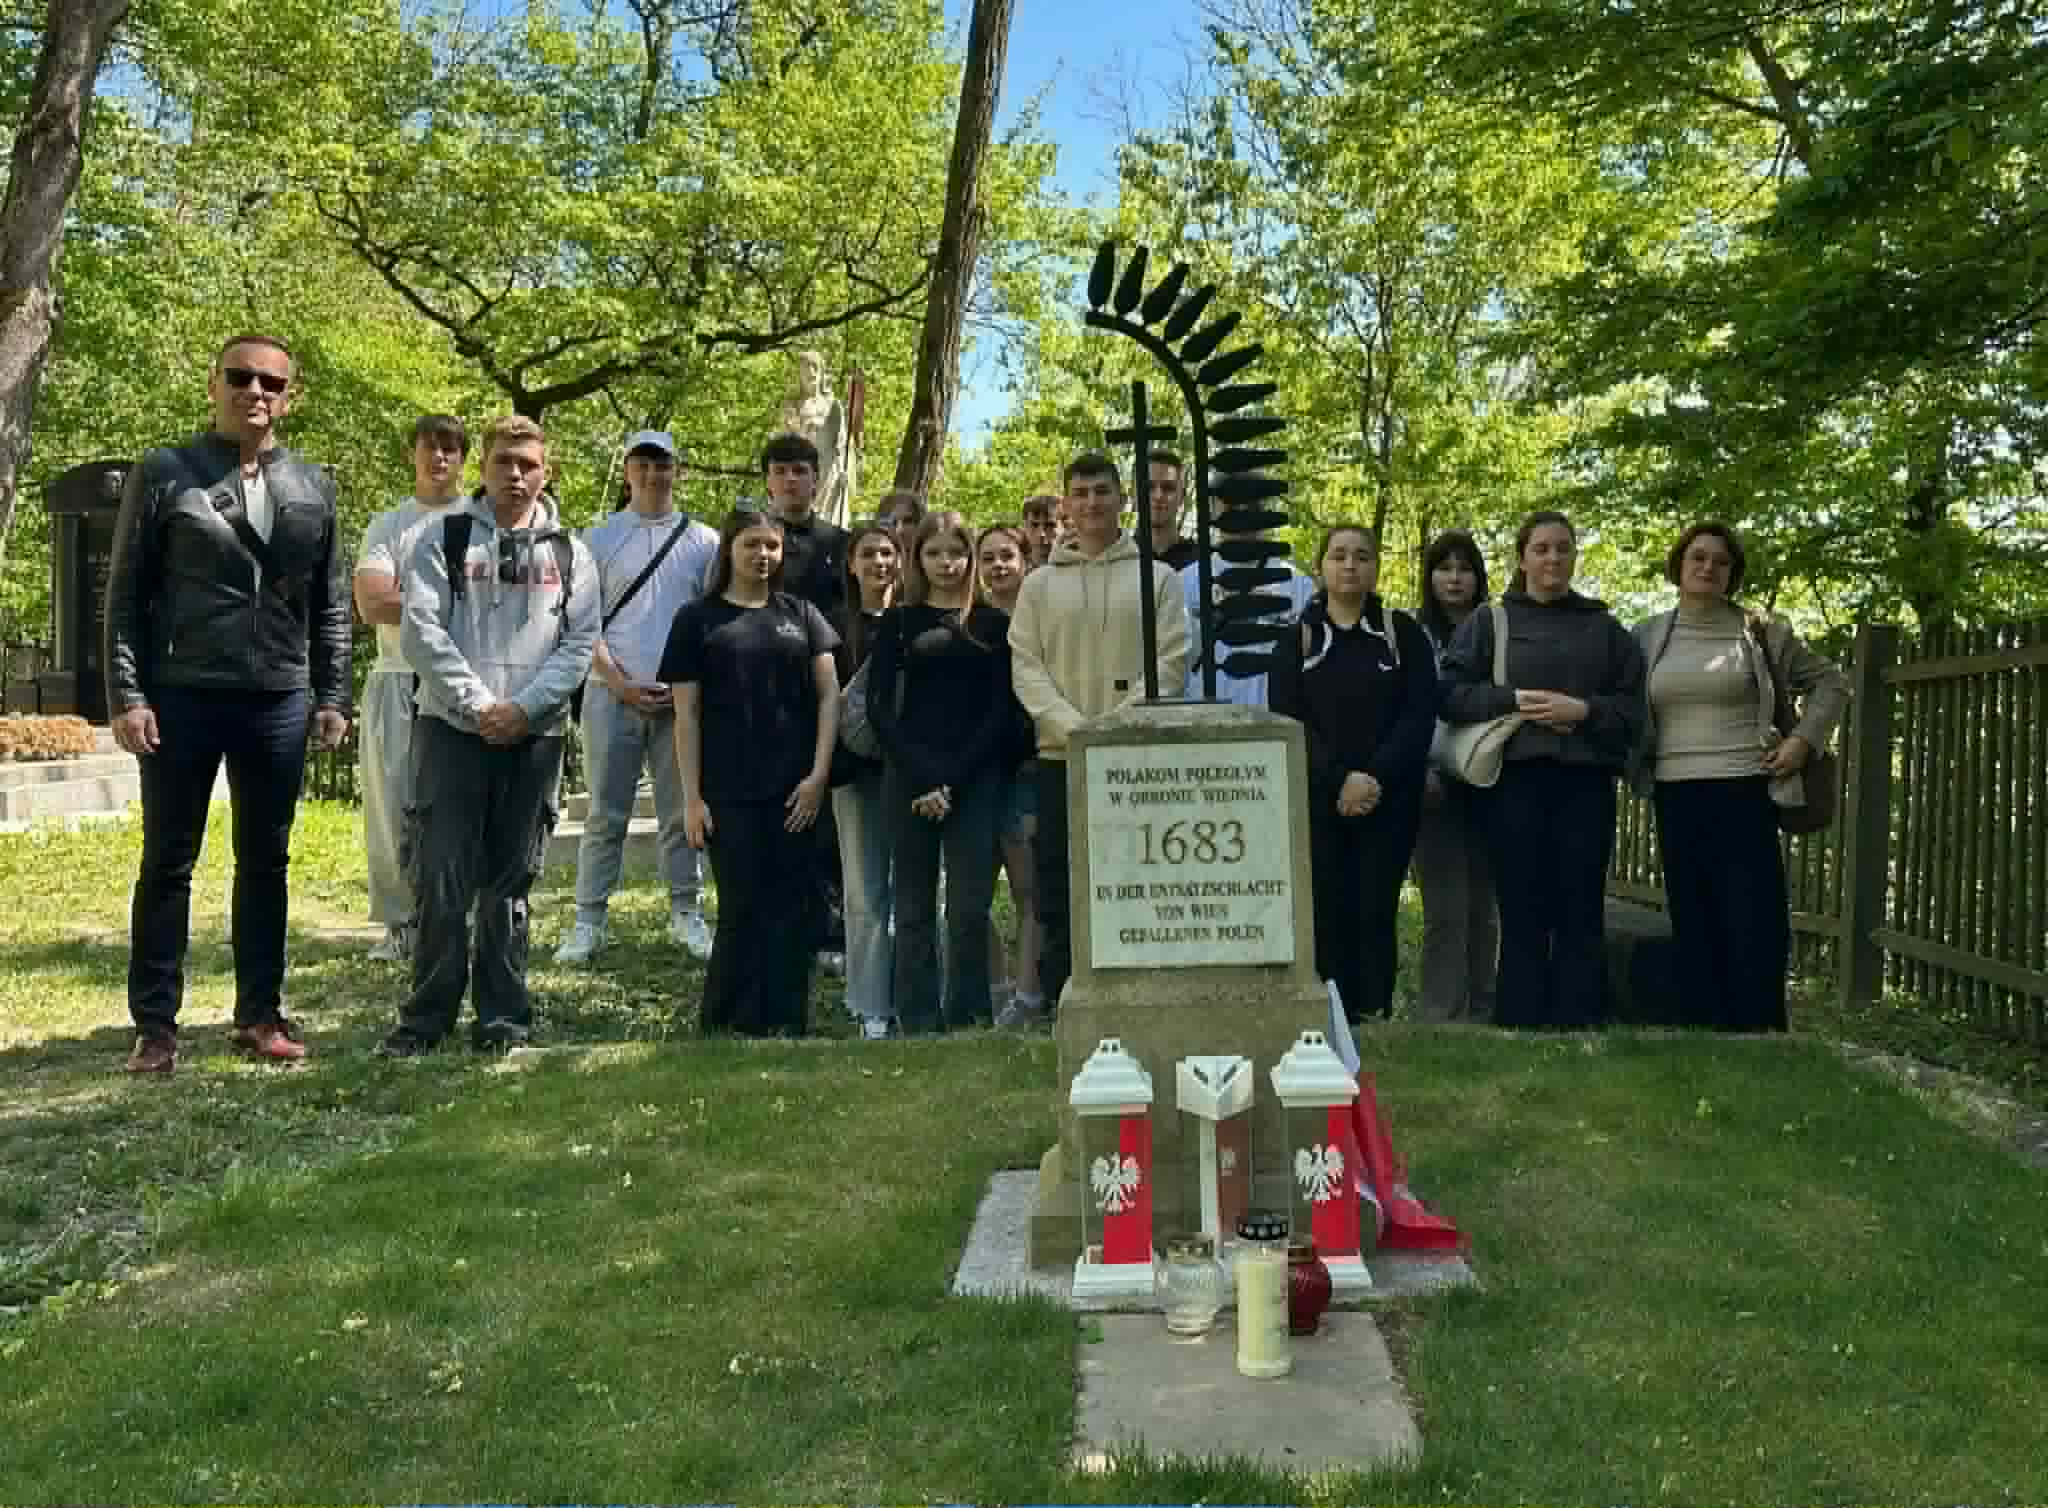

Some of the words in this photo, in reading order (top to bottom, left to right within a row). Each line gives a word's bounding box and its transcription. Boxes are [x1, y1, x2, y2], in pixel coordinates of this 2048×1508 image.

[1106, 767, 1178, 784] POLAKOM
[1109, 791, 1122, 805] W
[1202, 788, 1266, 802] WIEDNIA
[1137, 820, 1246, 864] 1683
[1096, 886, 1112, 901] IN
[1118, 885, 1144, 899] DER
[1155, 906, 1184, 920] VON
[1217, 927, 1265, 941] POLEN
